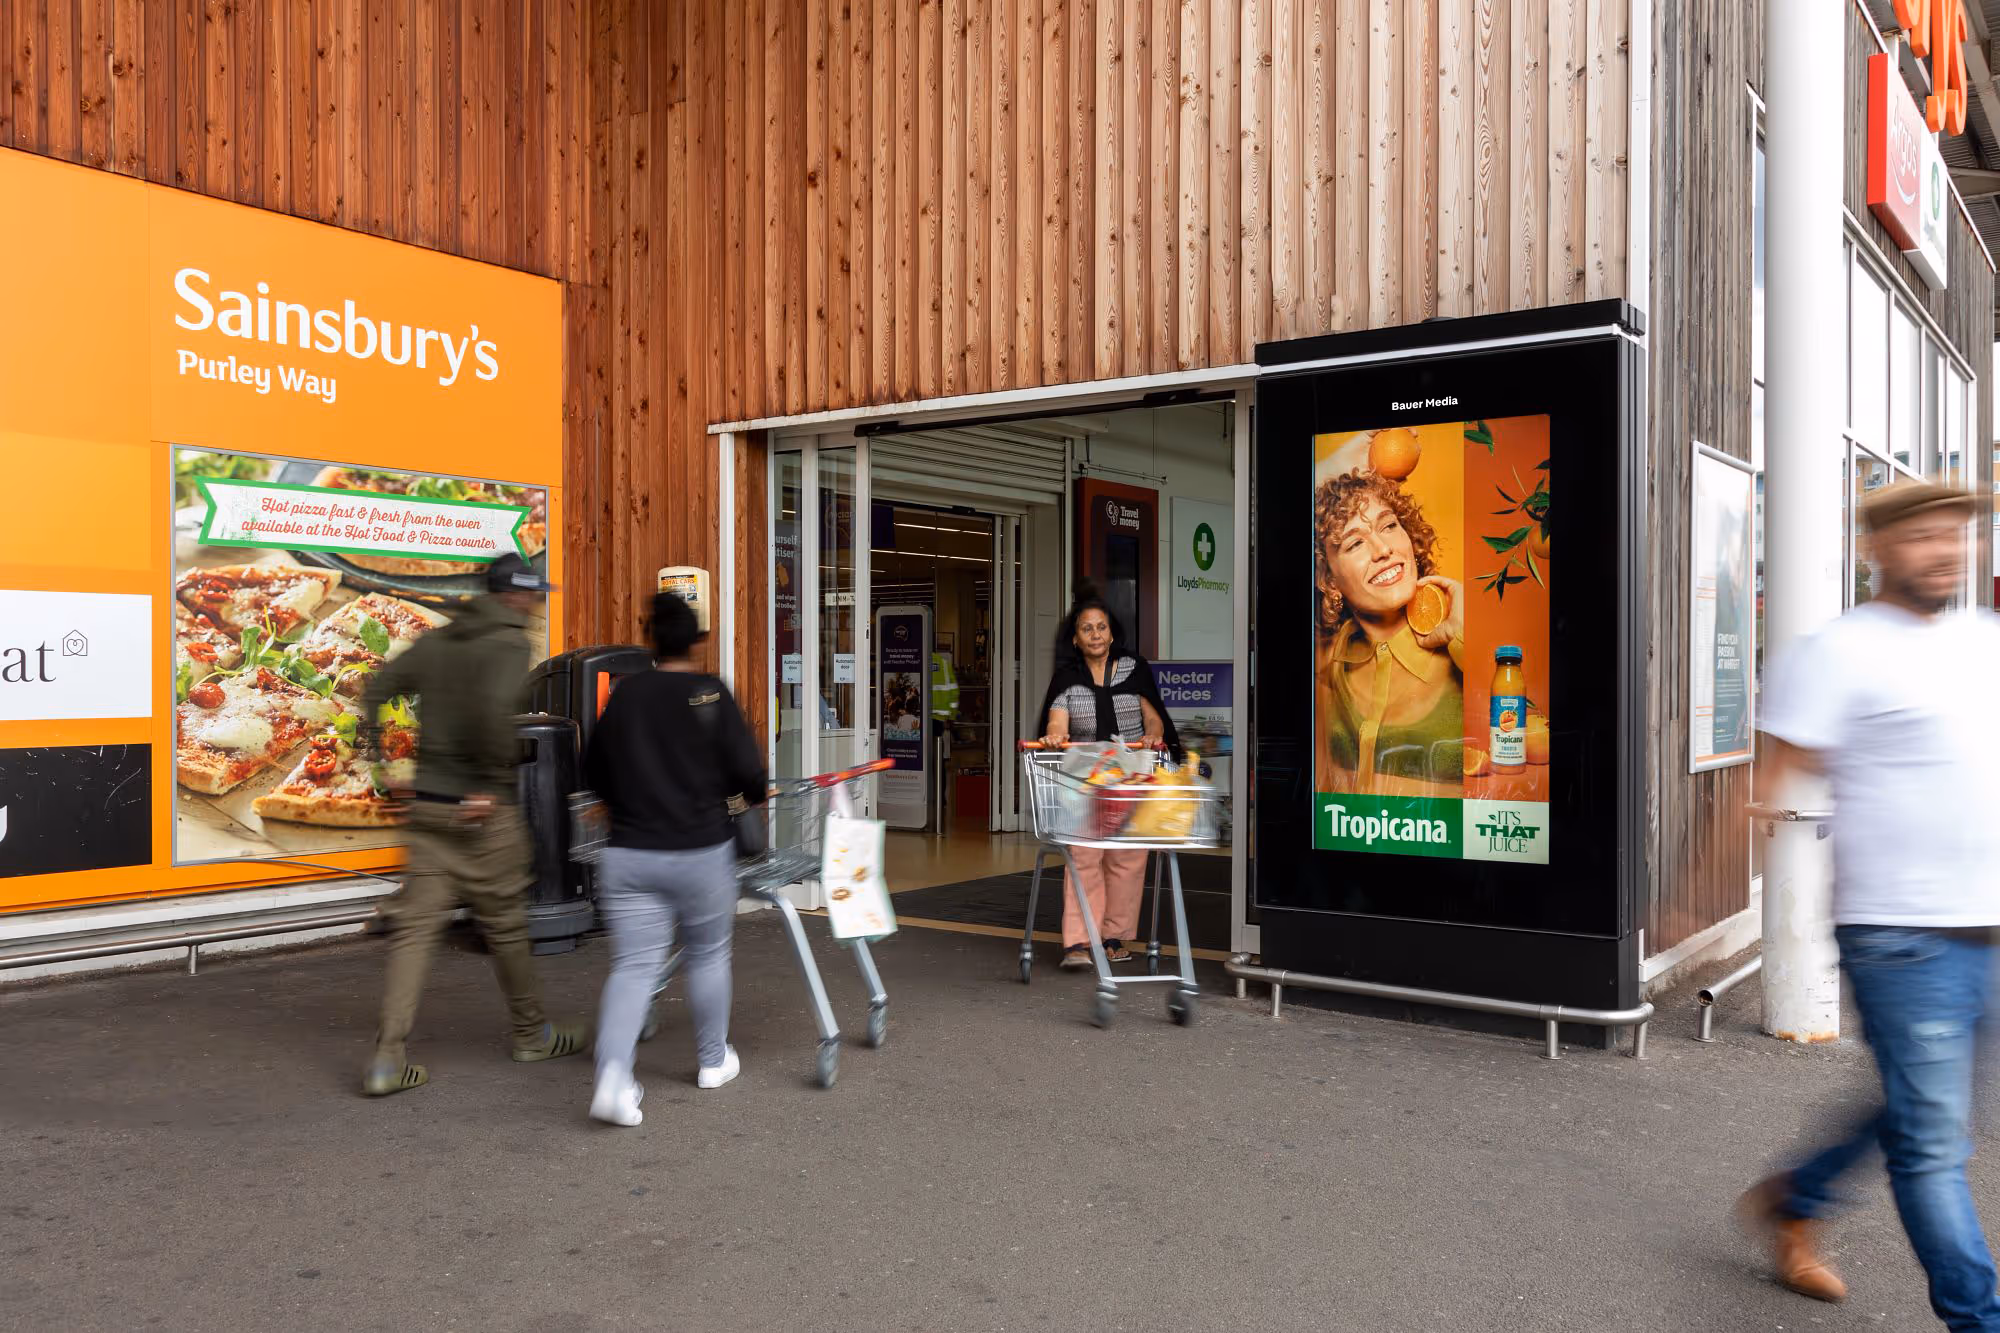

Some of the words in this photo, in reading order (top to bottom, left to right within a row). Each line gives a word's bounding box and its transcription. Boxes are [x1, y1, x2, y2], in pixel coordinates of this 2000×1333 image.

[1891, 94, 1917, 178] Argos
[174, 267, 499, 387] Sainsbury's
[177, 349, 271, 394] Purley
[278, 364, 337, 404] Way
[1391, 401, 1423, 411] Bauer
[1425, 395, 1459, 408] Media
[261, 497, 289, 515] Hot
[289, 502, 328, 517] pizza
[328, 503, 355, 521] fast
[357, 506, 368, 520] &
[368, 507, 402, 526] fresh
[401, 510, 433, 528] from
[434, 514, 454, 527] the
[455, 519, 481, 530] oven
[1120, 505, 1139, 519] Travel
[1119, 517, 1140, 531] money
[241, 519, 303, 535] available
[305, 523, 321, 536] at
[321, 523, 343, 538] the
[344, 524, 371, 541] Hot
[372, 526, 405, 542] Food
[407, 530, 418, 543] &
[419, 530, 454, 546] Pizza
[455, 536, 497, 550] counter
[1177, 575, 1230, 595] LloydsPharmacy
[1158, 671, 1215, 685] Nectar
[1160, 687, 1212, 701] Prices
[1495, 733, 1523, 744] Tropicana
[1324, 803, 1447, 845] Tropicana
[1497, 810, 1521, 826] IT'S
[1475, 823, 1541, 840] THAT
[1488, 837, 1528, 854] JUICE
